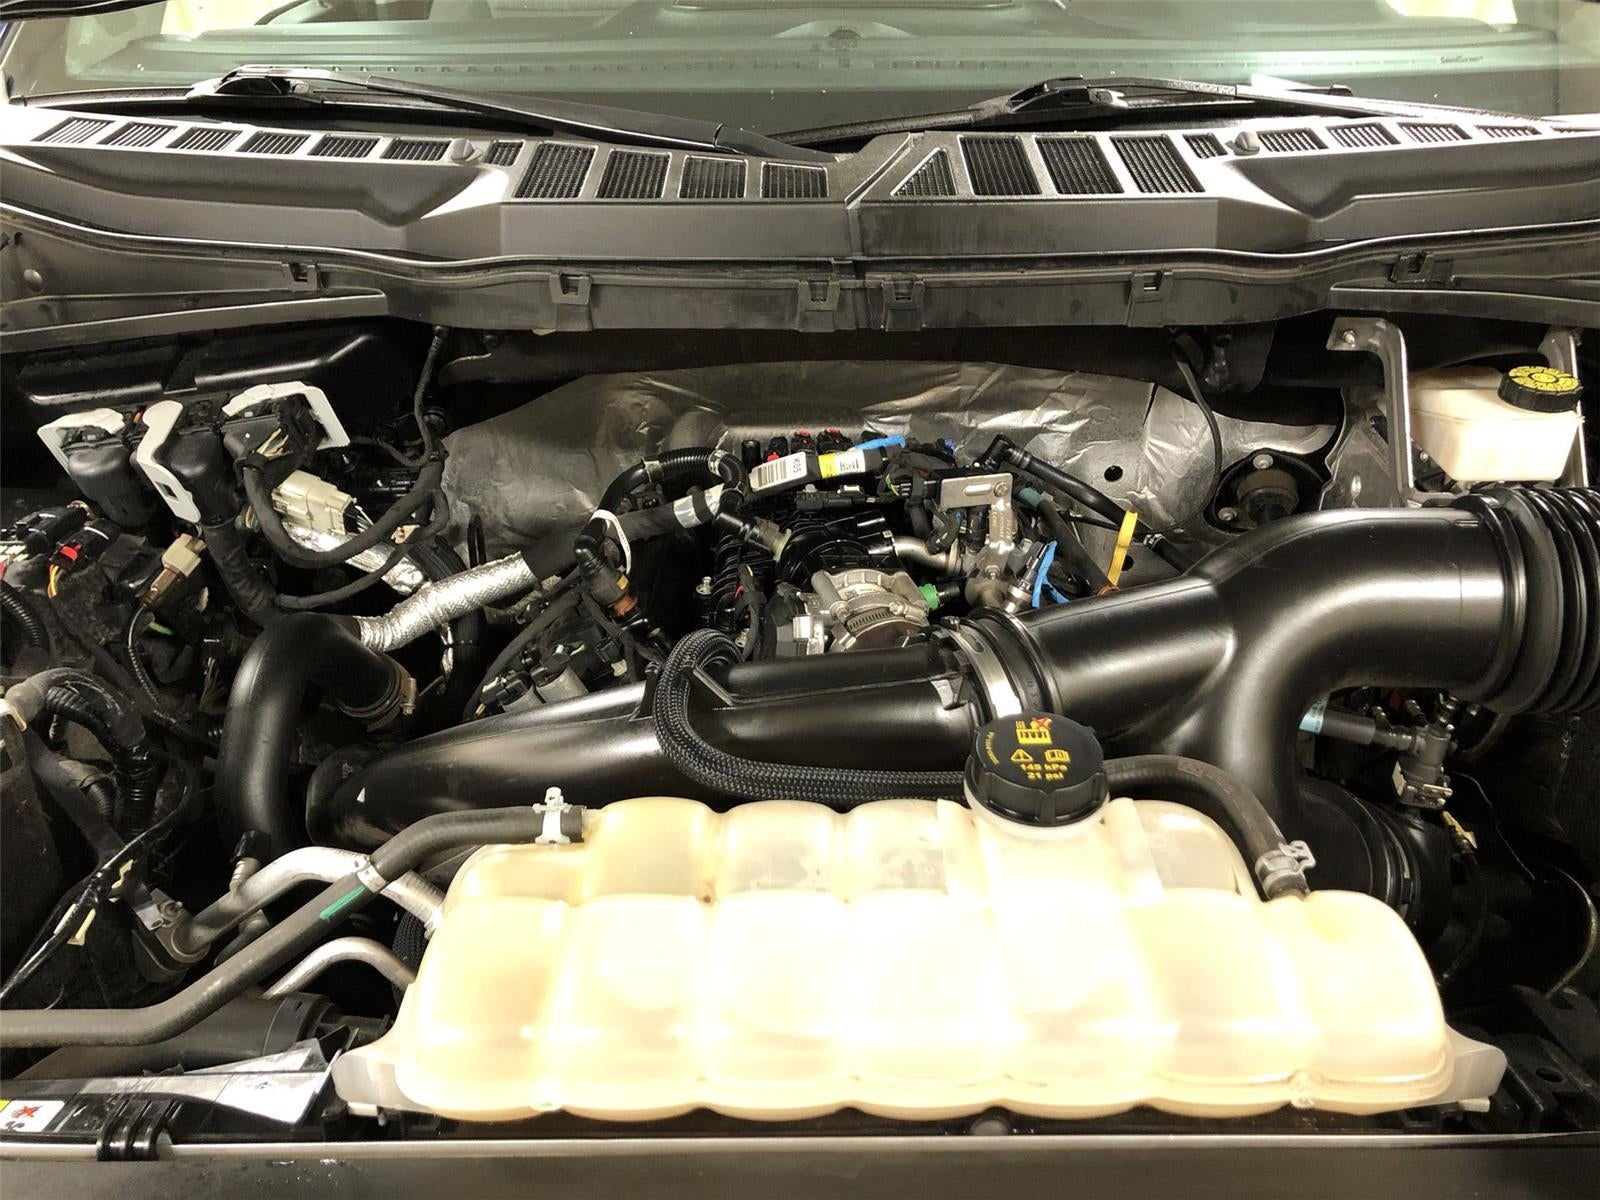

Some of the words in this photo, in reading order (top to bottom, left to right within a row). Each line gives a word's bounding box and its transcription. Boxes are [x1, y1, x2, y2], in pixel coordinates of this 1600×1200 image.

[1044, 763, 1068, 771] kPa
[1026, 772, 1042, 780] 21
[1044, 772, 1065, 781] psi
